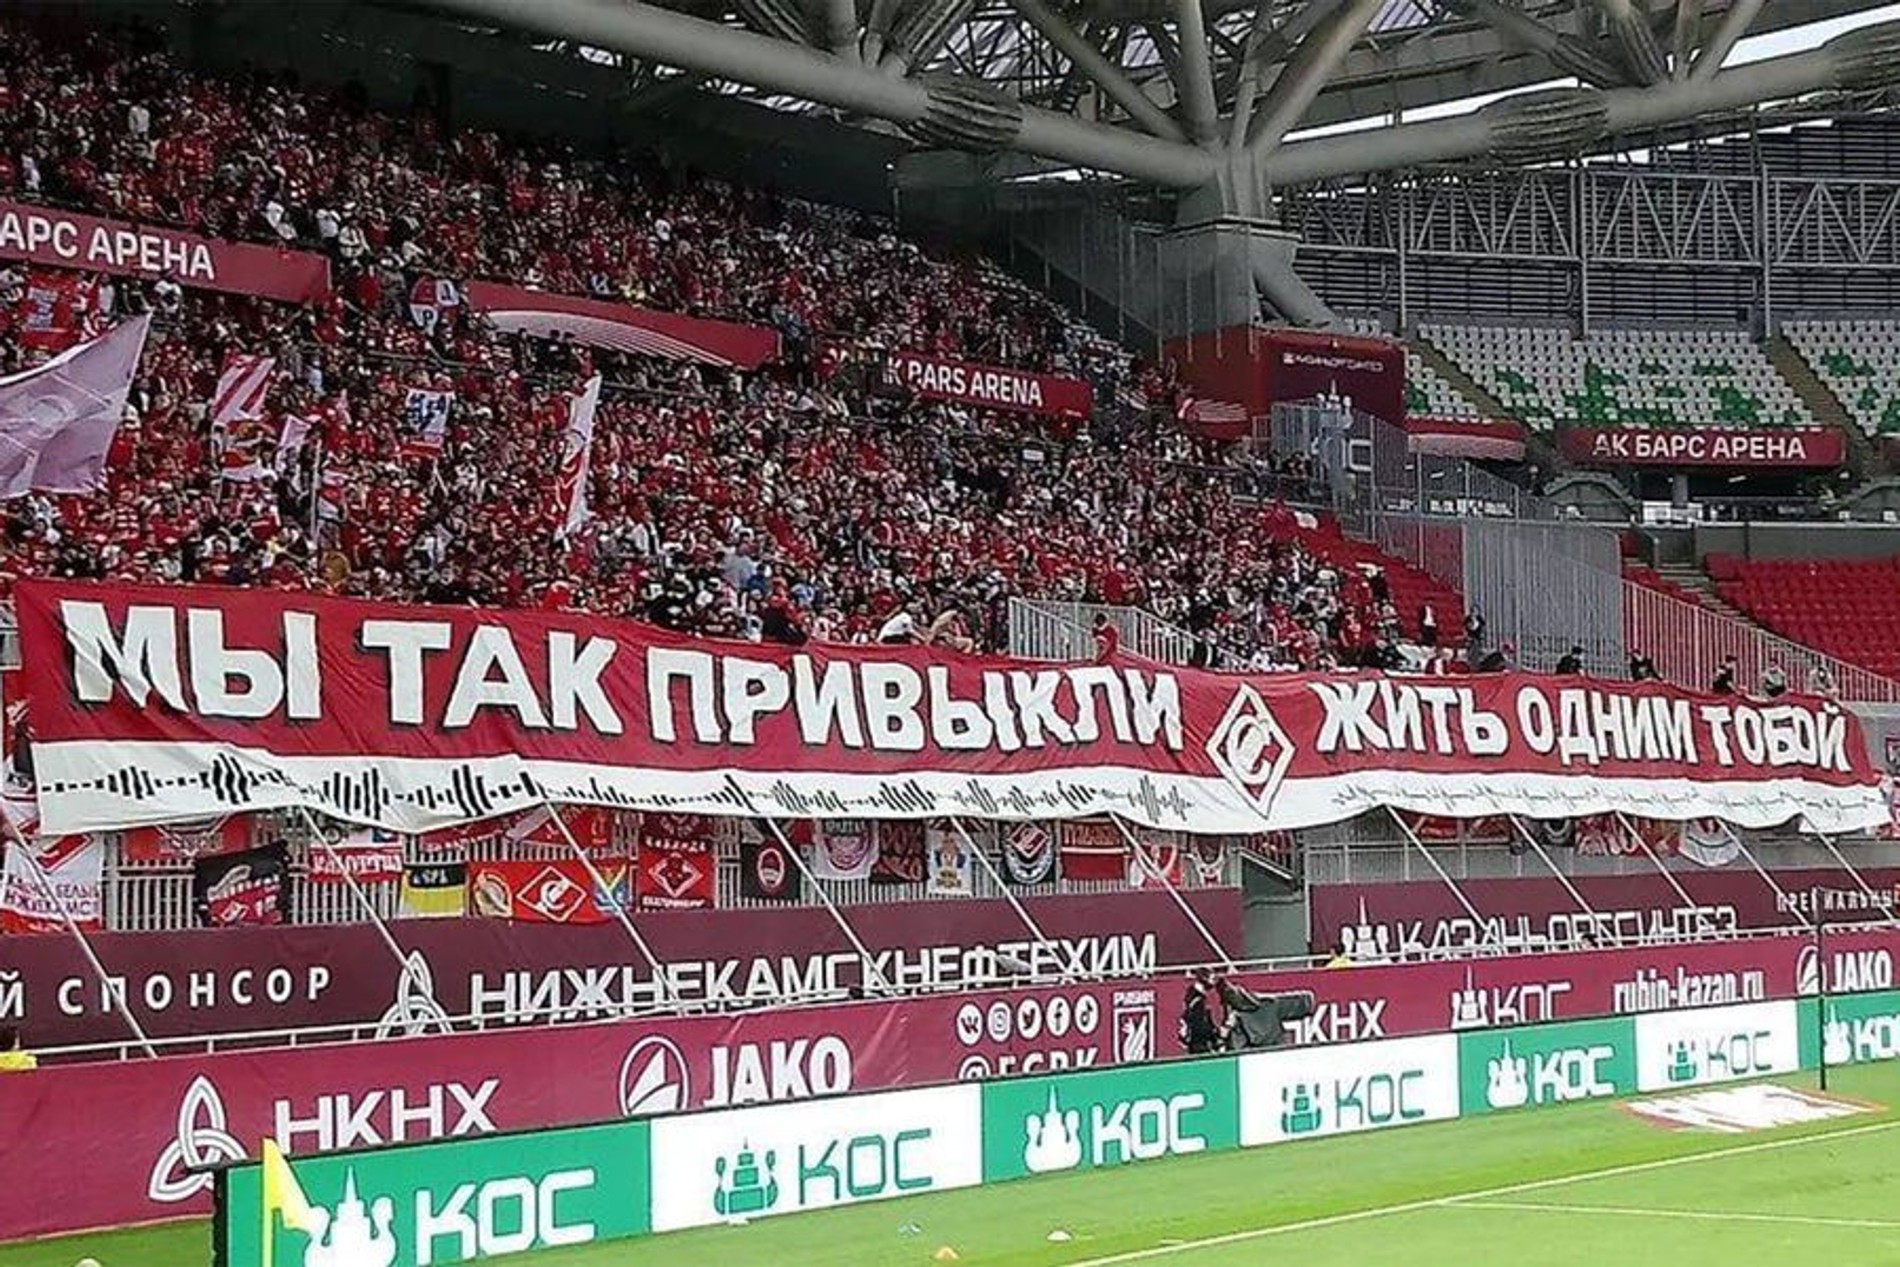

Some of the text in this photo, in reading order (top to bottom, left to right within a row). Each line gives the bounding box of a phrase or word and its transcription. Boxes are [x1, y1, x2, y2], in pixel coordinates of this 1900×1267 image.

[88, 226, 215, 280] АРЕНА
[969, 371, 1043, 407] ARENA
[1592, 434, 1806, 459] АК БАРС АРЕНА
[60, 600, 1852, 773] МЫ ТАК ПРИВЫКЛИ ЖИТЬ ОДНИМ ТОБОЙ
[57, 966, 332, 1015] СПОНСОР
[1614, 966, 1764, 1013] rubin-kazan.ru
[1830, 950, 1893, 992] JAKO
[703, 1037, 850, 1108] JAKO
[1534, 1046, 1617, 1104] КОС
[1708, 1030, 1773, 1074] КОС
[275, 1079, 500, 1152] НКНХ
[1335, 1069, 1425, 1127] КОС
[1091, 1092, 1207, 1166] КОС
[799, 1127, 933, 1205] КОС
[415, 1168, 596, 1267] КОС
